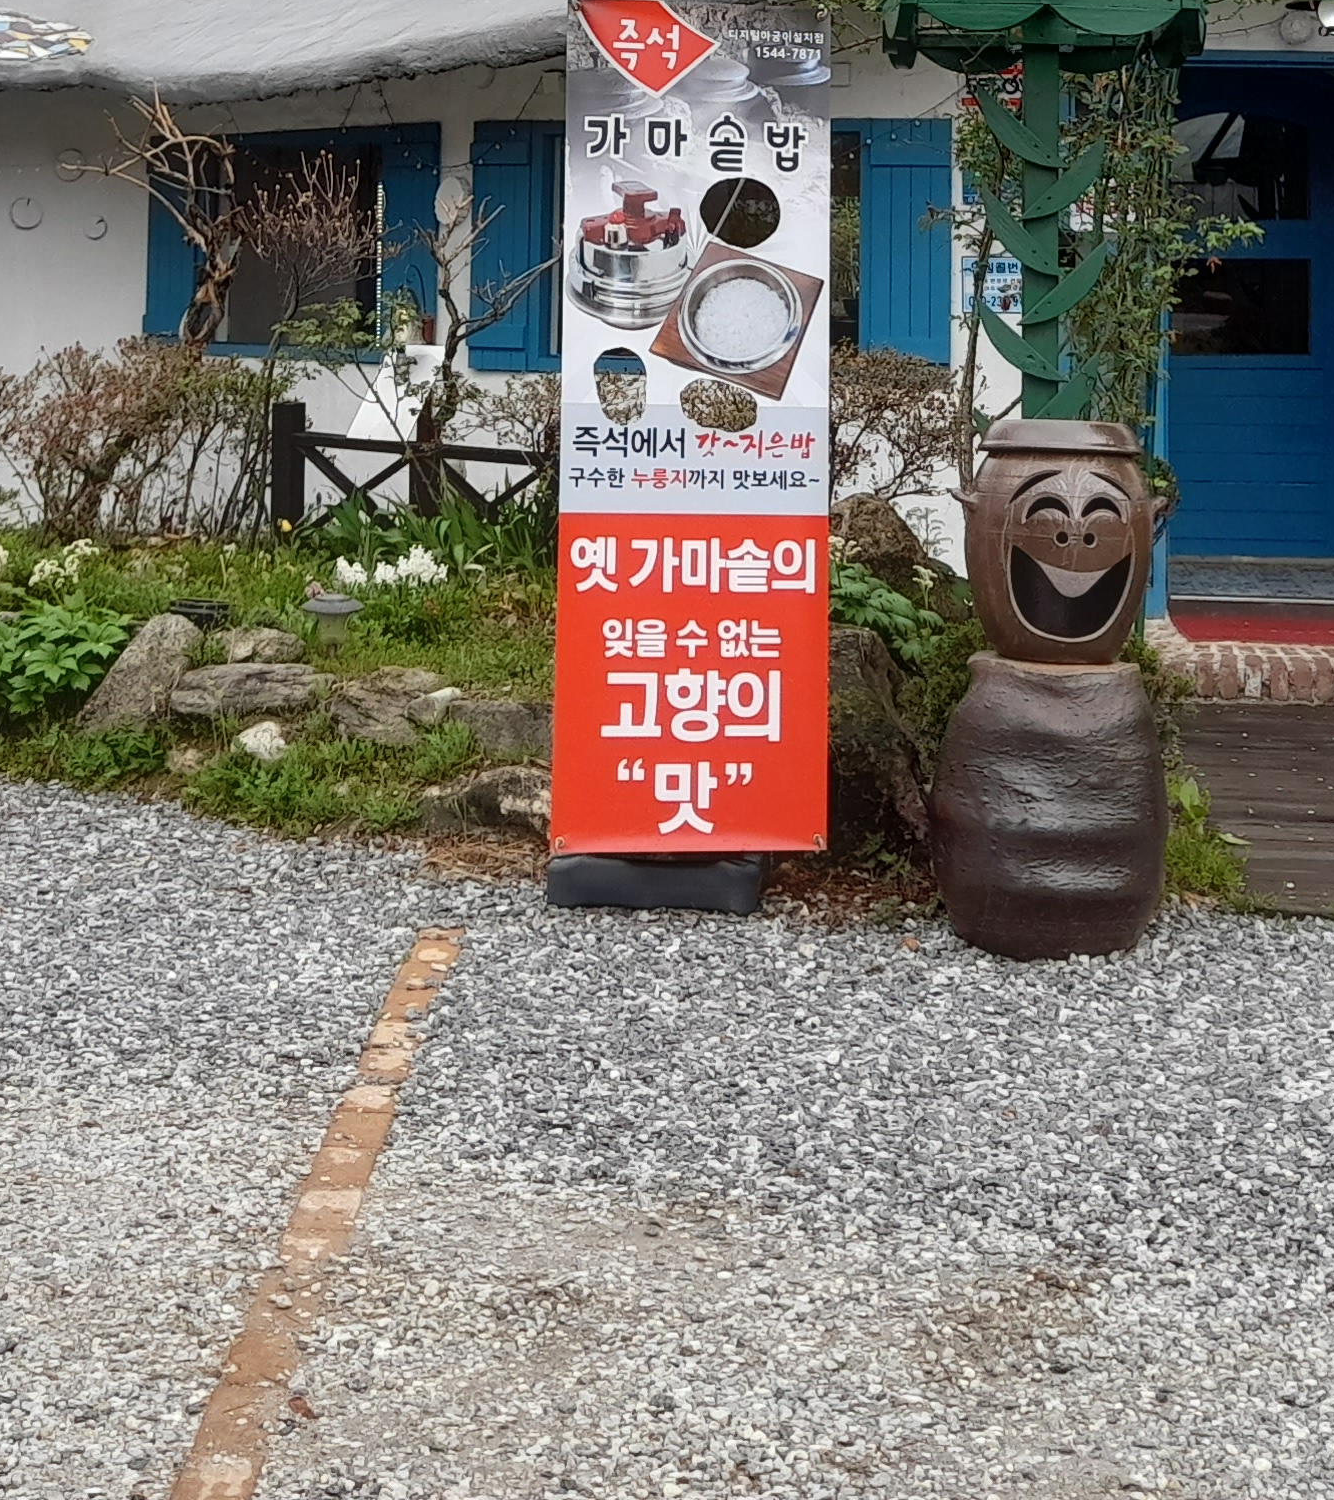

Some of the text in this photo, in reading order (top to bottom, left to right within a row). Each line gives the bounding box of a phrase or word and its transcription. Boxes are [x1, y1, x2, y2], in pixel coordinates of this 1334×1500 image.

[613, 18, 680, 71] 즉석
[755, 46, 822, 61] 1544-7871
[572, 426, 686, 459] 즉석에서
[568, 467, 820, 491] 구수한 누룽지까지 맛보세요~
[570, 536, 816, 594] 옛 가마솥의
[602, 618, 782, 658] 잊을 수 없는
[600, 667, 781, 742] 고향의
